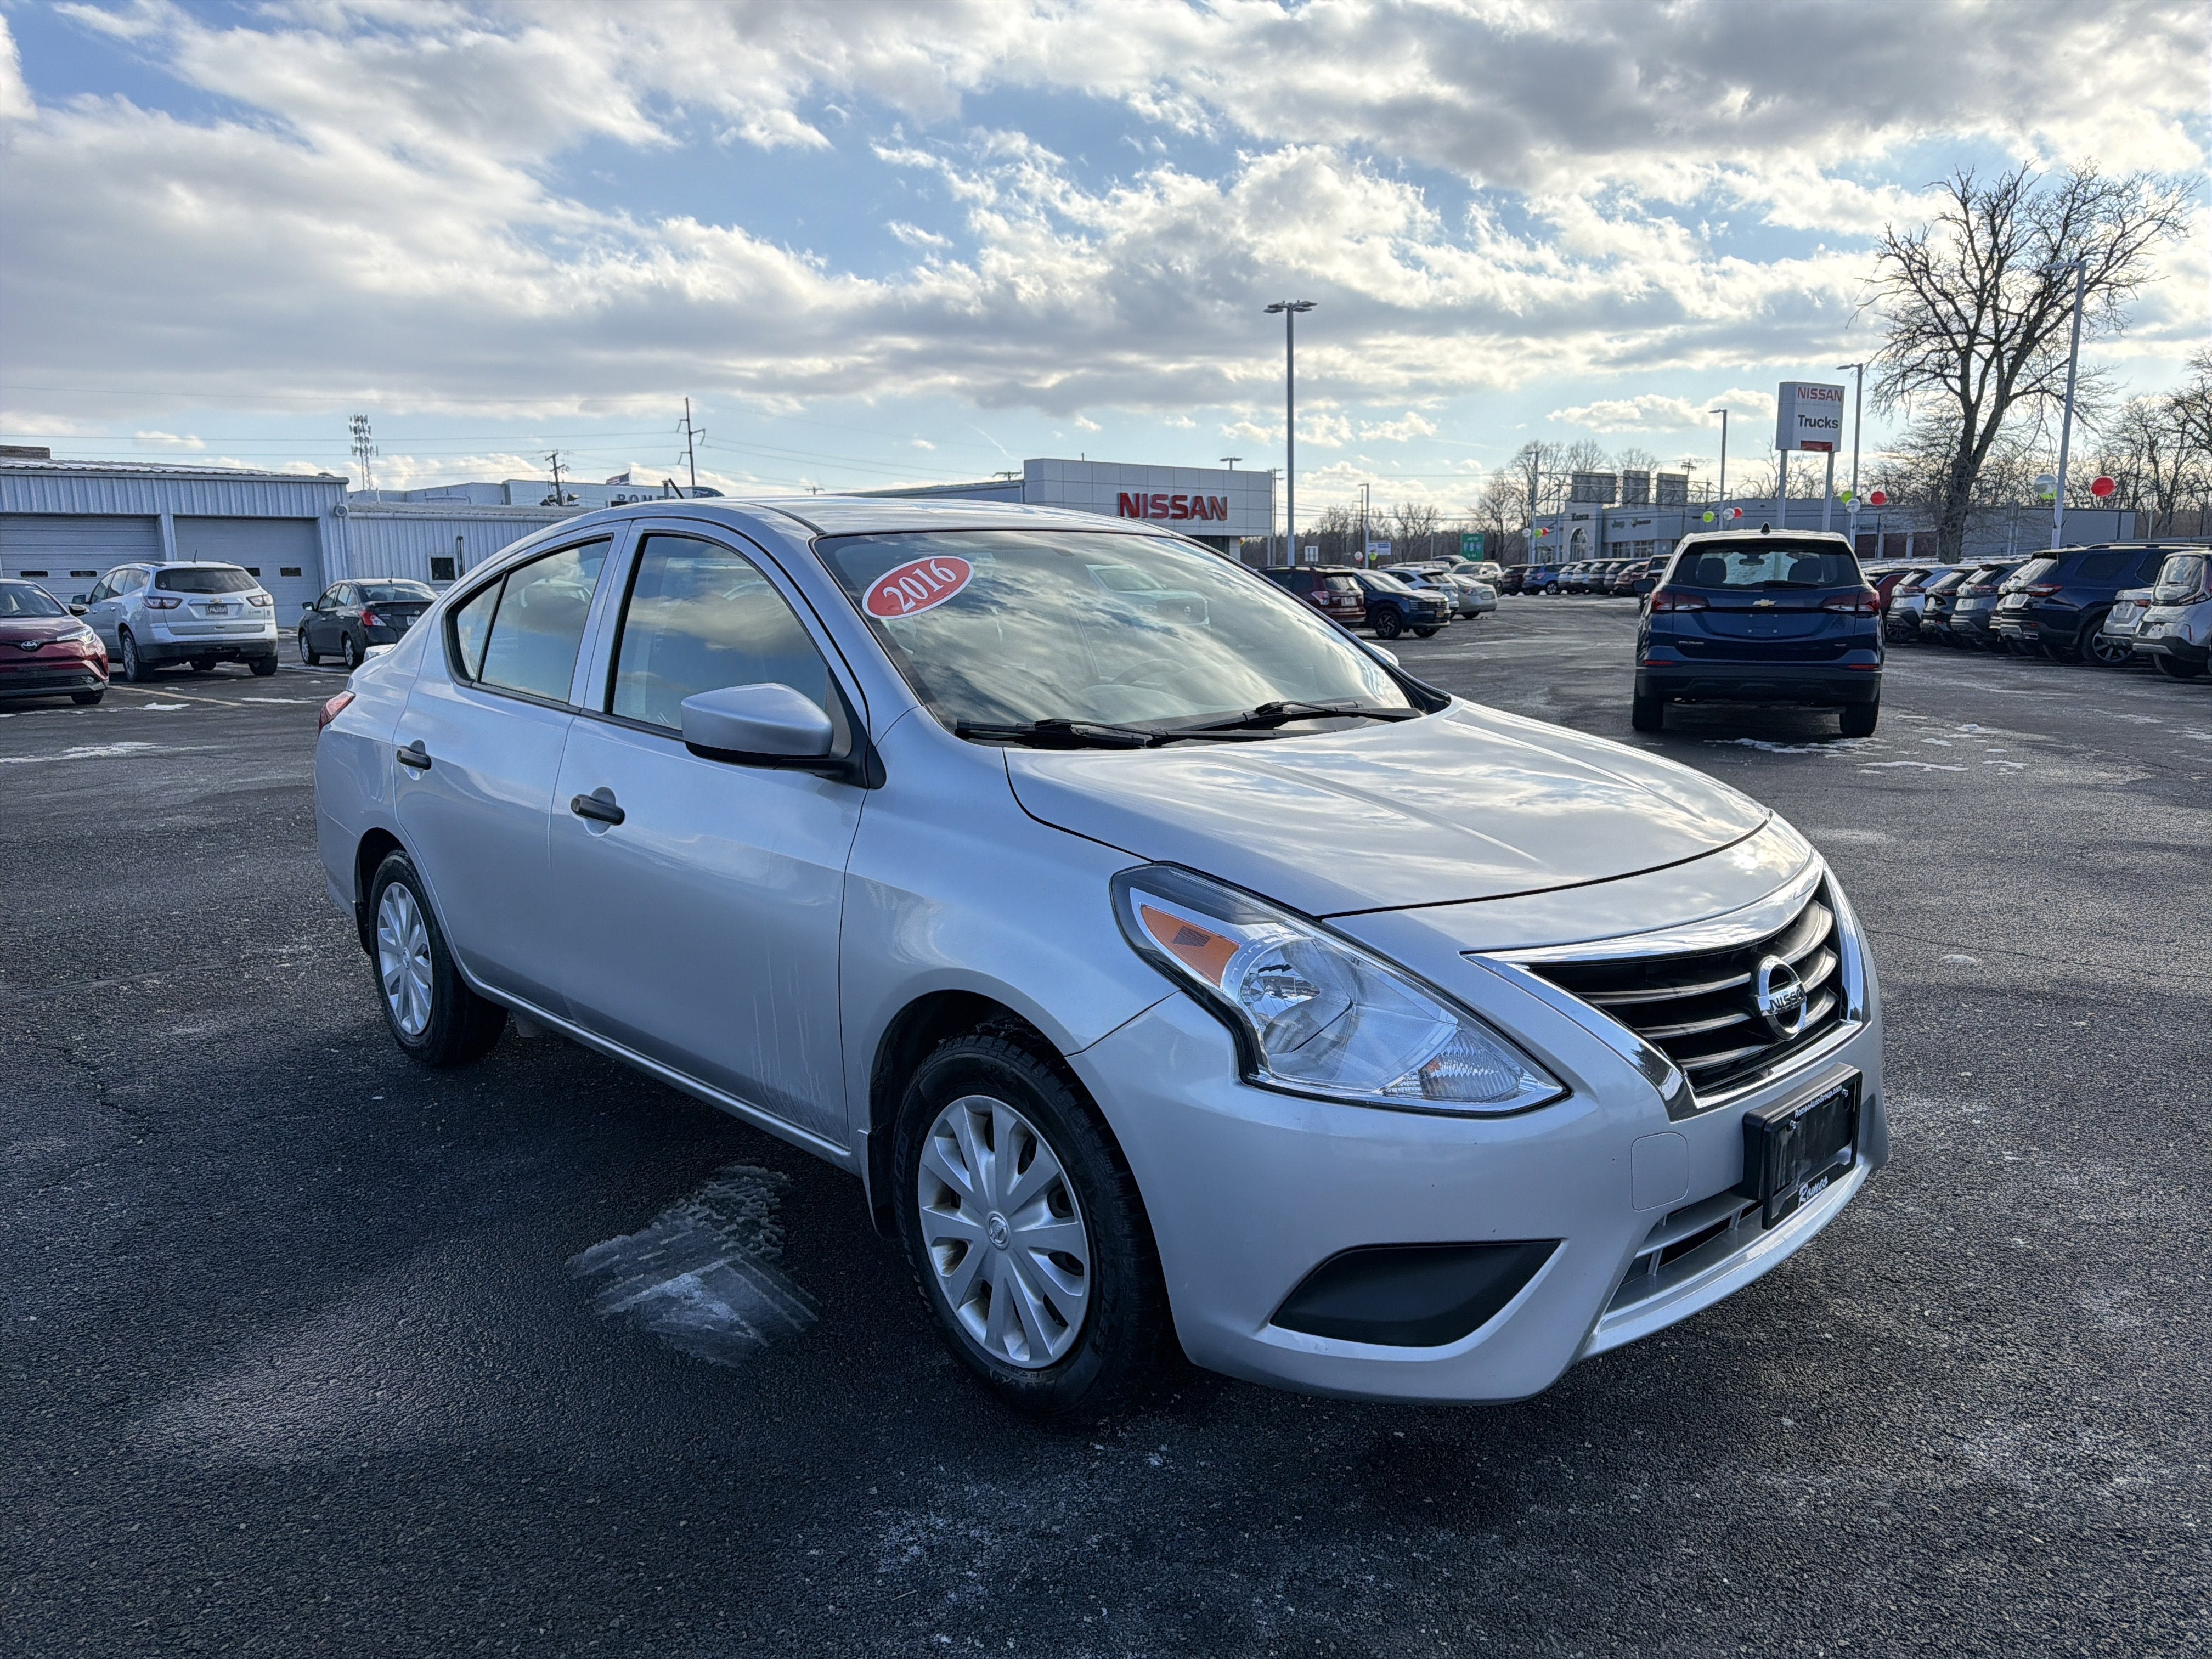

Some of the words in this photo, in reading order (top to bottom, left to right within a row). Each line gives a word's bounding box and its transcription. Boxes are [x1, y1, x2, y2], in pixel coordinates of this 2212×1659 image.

[1797, 386, 1842, 402] NISSAN
[1798, 414, 1838, 428] Trucks
[1118, 492, 1228, 521] NISSAN
[883, 560, 956, 612] 2016
[1795, 1085, 1842, 1119] RomeoAutoGroup.com
[1798, 1175, 1829, 1207] Romeo
